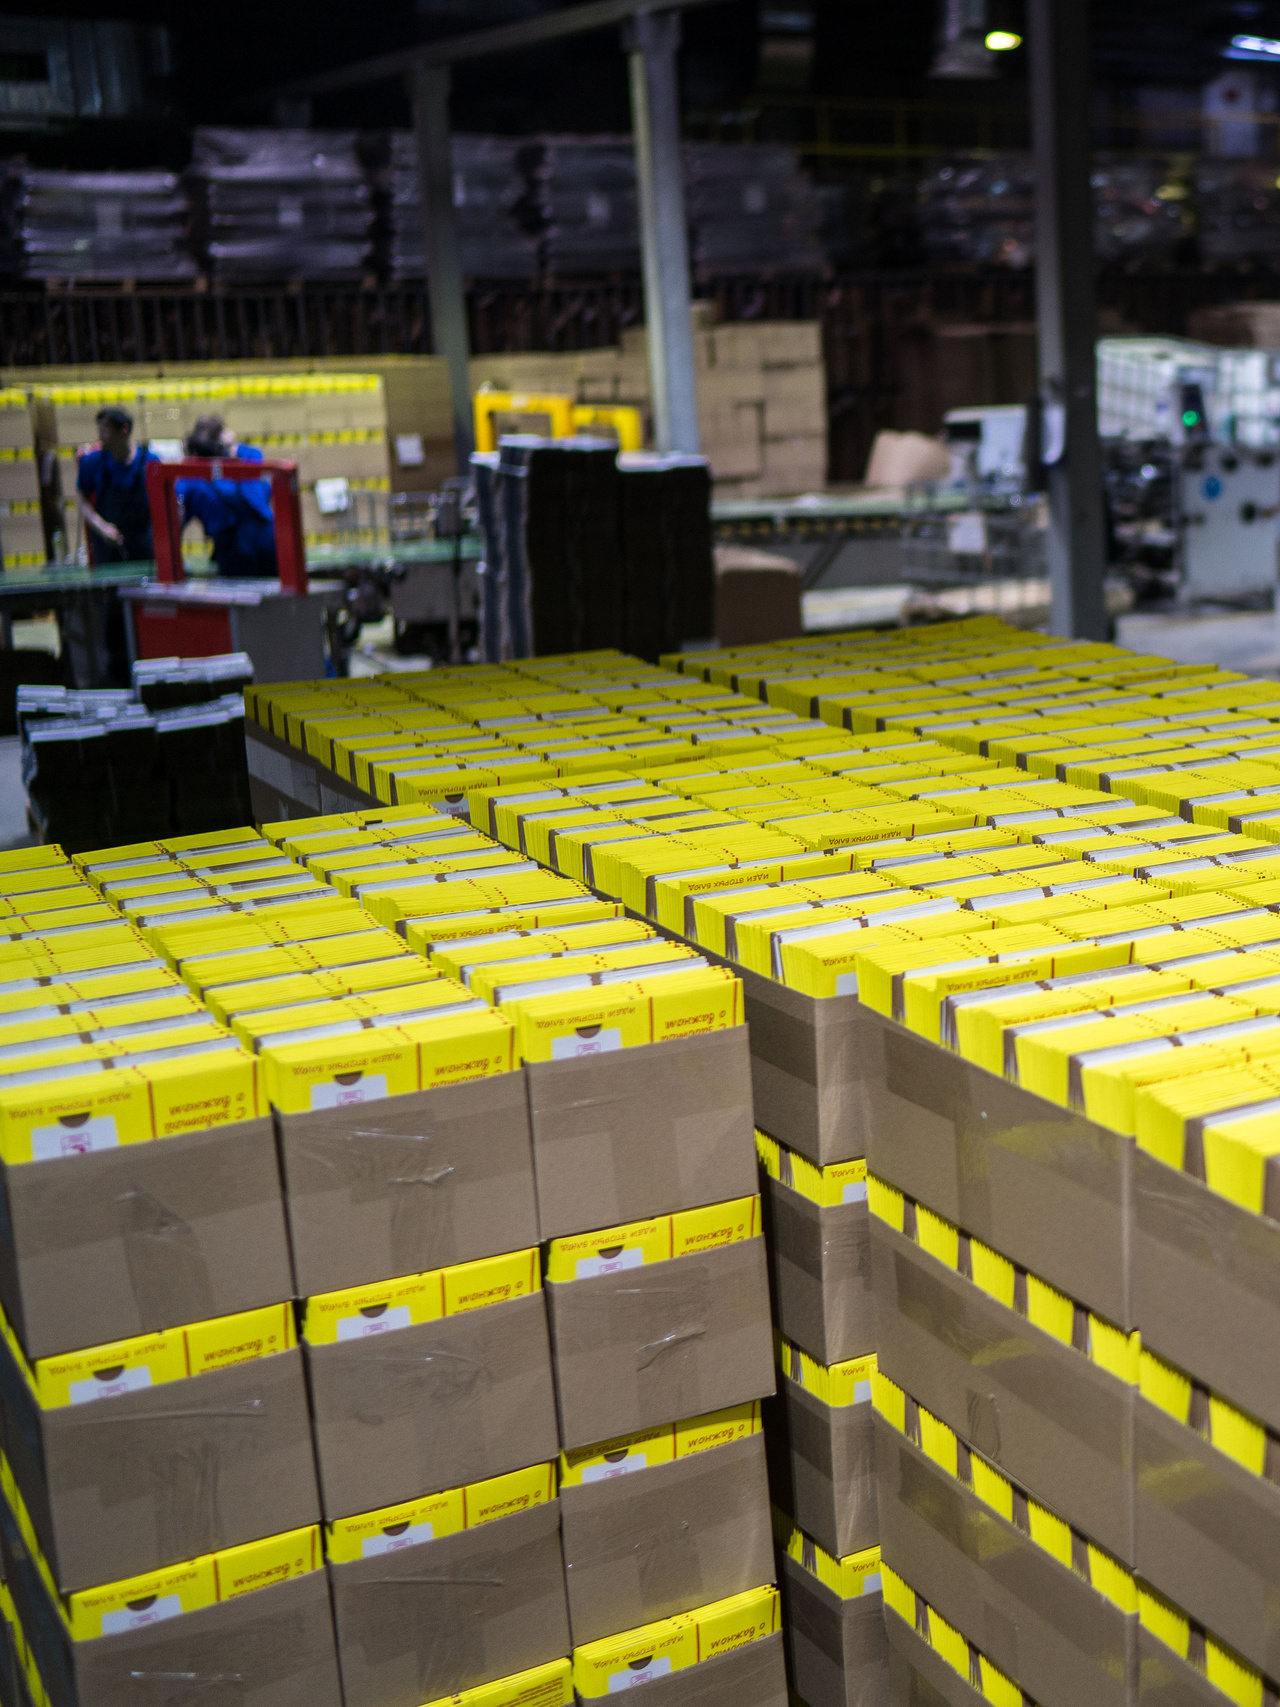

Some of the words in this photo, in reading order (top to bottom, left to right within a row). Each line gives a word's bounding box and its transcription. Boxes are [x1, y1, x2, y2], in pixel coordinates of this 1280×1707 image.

[440, 786, 466, 794] ВТОРЫХ
[468, 783, 487, 791] ИДЕИ
[852, 834, 879, 842] ВТОРЫХ
[882, 831, 901, 839] ИДЕИ
[714, 877, 744, 888] ВТОРЫХ
[747, 873, 769, 882] ИДЕИ
[430, 932, 457, 941] БЛЮД
[460, 927, 494, 937] ВТОРЫХ
[1013, 969, 1038, 980] ИДЕИ
[946, 982, 973, 992] БЛЮД
[976, 975, 1010, 988] ВТОРЫХ
[568, 1012, 605, 1023] ВТОРЫХ
[608, 1007, 635, 1017] ИДЕИ
[719, 1010, 726, 1018] о
[665, 1012, 715, 1029] важном
[372, 1053, 402, 1064] ИДЕИ
[493, 1056, 502, 1064] о
[435, 1057, 490, 1075] важном
[236, 1092, 246, 1102] о
[169, 1095, 230, 1115] важном
[629, 1226, 657, 1238] ИДЕИ
[685, 1227, 734, 1245] важном
[591, 1233, 627, 1245] ВТОРЫХ
[560, 1241, 588, 1252] БЛЮД
[515, 1280, 523, 1288] о
[457, 1284, 511, 1304] важном
[268, 1335, 276, 1343] о
[688, 1427, 734, 1448] важном
[533, 1490, 542, 1498] о
[420, 1501, 449, 1513] ИДЕИ
[479, 1493, 530, 1517] важном
[295, 1558, 304, 1566] о
[233, 1563, 290, 1587] важном
[759, 1622, 766, 1630] о
[659, 1635, 684, 1648] ИДЕИ
[711, 1626, 756, 1649] важном
[622, 1644, 657, 1659] ВТОРЫХ
[593, 1656, 620, 1668] БЛЮД
